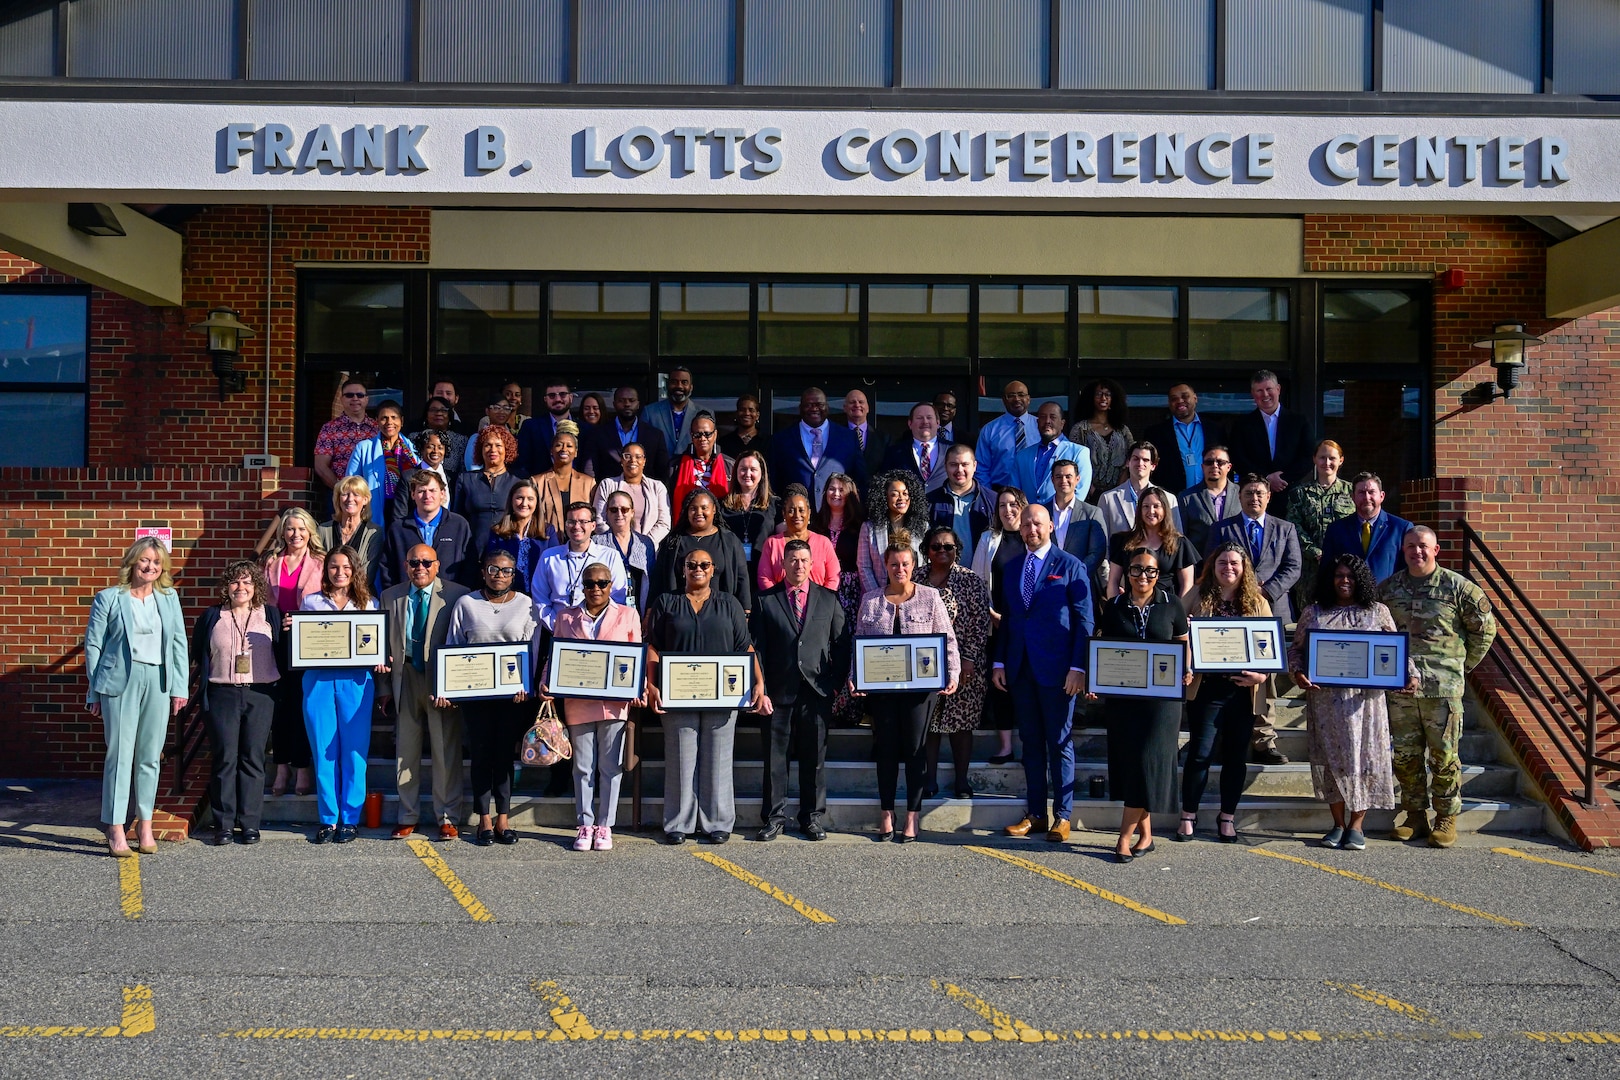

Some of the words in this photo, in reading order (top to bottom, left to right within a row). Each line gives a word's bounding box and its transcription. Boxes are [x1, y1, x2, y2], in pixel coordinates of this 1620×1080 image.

[226, 122, 430, 170] FRANK
[478, 125, 534, 171] B.
[583, 125, 784, 175] LOTTS
[836, 127, 1276, 180] CONFERENCE
[1324, 133, 1570, 183] CENTER
